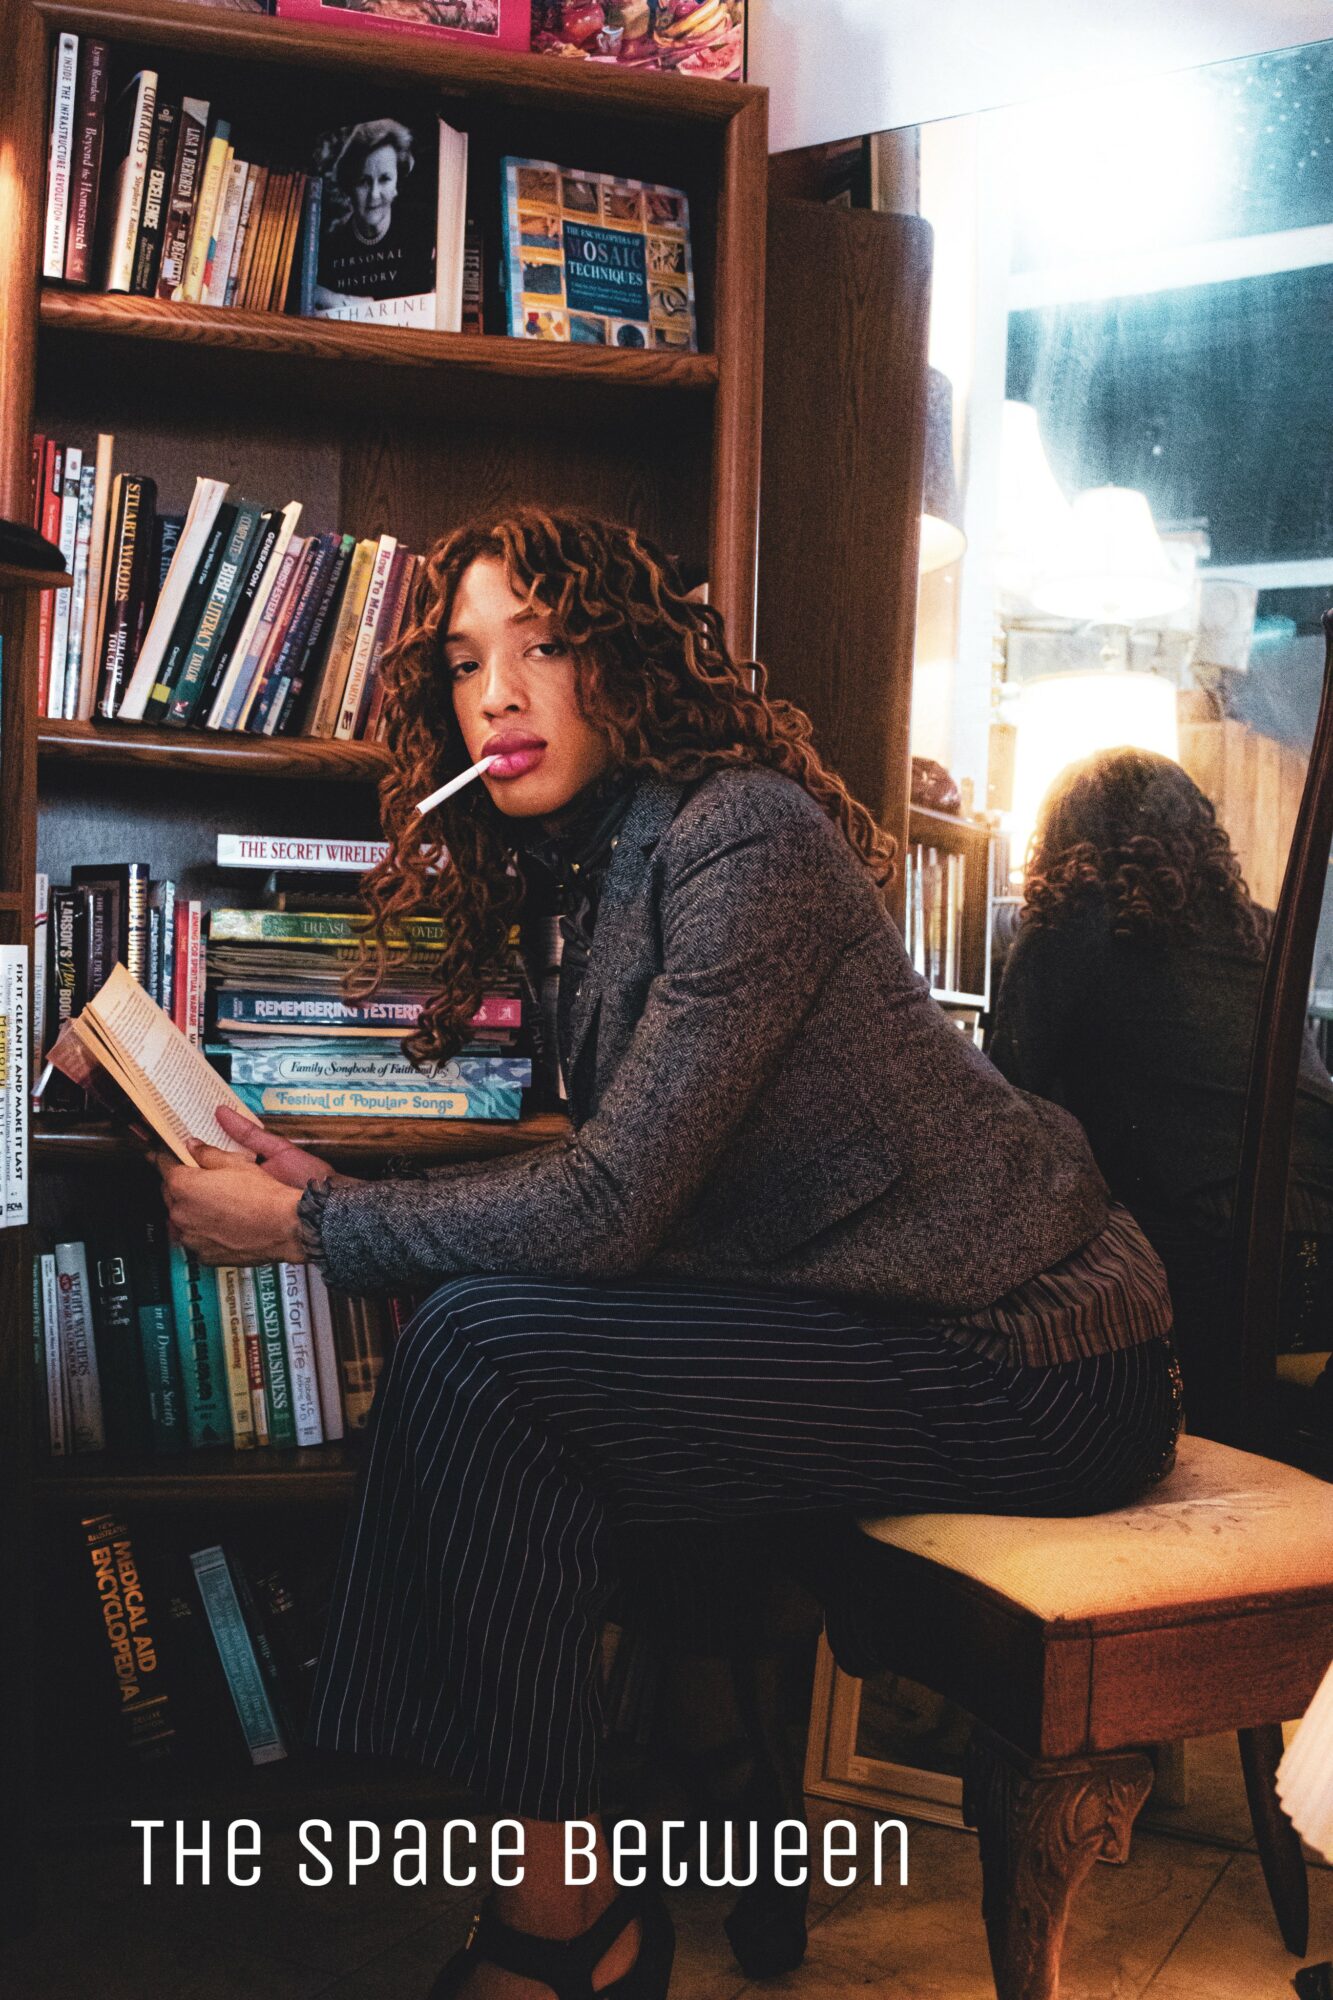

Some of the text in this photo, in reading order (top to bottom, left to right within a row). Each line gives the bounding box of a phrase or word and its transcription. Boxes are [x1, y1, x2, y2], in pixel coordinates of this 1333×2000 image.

[90, 46, 103, 101] Lynn Reardon
[136, 87, 156, 154] COMRADES
[54, 57, 72, 221] INSIDE THE INFRASTRUCTURE REVOLUTION
[82, 128, 97, 165] Beyond
[177, 128, 201, 197] LISA T. BERGREN
[131, 176, 143, 206] Stephen
[143, 169, 165, 230] EXCELLENCE
[75, 182, 93, 250] Homestretch
[126, 218, 137, 250] Ambrose
[176, 230, 186, 239] THE
[567, 226, 640, 246] THE ENCYCLOPEDIA OF
[168, 241, 186, 286] BEGOTTEN
[333, 249, 403, 268] PERSONAL
[568, 237, 641, 268] MOSAIC
[337, 270, 397, 288] HISTORY
[568, 260, 643, 286] TECHNIQUES
[65, 515, 74, 534] HOW
[162, 521, 182, 552] JACK
[63, 539, 72, 551] TO
[116, 483, 141, 602] STUART WOODS
[314, 550, 326, 566] THE
[249, 532, 275, 587] GENERATION
[328, 559, 344, 583] WHEN
[377, 550, 392, 575] How
[196, 515, 252, 651] COMPLETE BIBLE LITERACY
[262, 555, 294, 622] CHRIST-ESTEEM
[300, 567, 320, 601] COMING
[372, 580, 384, 595] To
[288, 601, 306, 633] REVIVAL
[364, 597, 380, 628] Meet
[105, 633, 118, 672] TOUCH
[114, 620, 128, 685] A DELICATE
[357, 632, 373, 658] GENE
[185, 652, 204, 683] TAYLOR
[211, 654, 228, 686] TIM ELMORE
[346, 662, 366, 706] EDWARDS
[239, 840, 267, 858] THE
[270, 842, 320, 860] SECRET
[60, 901, 74, 958] LARSON'S
[94, 915, 104, 957] PURPOSE
[15, 987, 23, 1001] IT,
[59, 989, 73, 1019] BOOK
[254, 1000, 358, 1018] REMEMBERING
[33, 964, 43, 1060] THE AMERICAN DREAM
[15, 1048, 23, 1062] IT,
[290, 1061, 324, 1077] Family
[324, 1062, 375, 1078] Songbook
[377, 1062, 387, 1076] of
[389, 1062, 414, 1076] Faith
[15, 1065, 23, 1093] AND
[275, 1091, 454, 1114] Festival of Popular Songs
[16, 1136, 22, 1148] IT
[71, 1272, 90, 1377] WEIGHT WATCHERS
[225, 1270, 243, 1370] Lasagna Gardening
[288, 1301, 303, 1328] for
[258, 1264, 287, 1409] ME-BASED BUSINESS
[291, 1332, 308, 1369] Life
[153, 1307, 176, 1427] in a Dynamic Society
[251, 1339, 261, 1385] FITNESS
[304, 1377, 313, 1401] Robert
[112, 1539, 158, 1673] MEDICAL AID
[91, 1545, 141, 1702] ENCYCLOPEDIA
